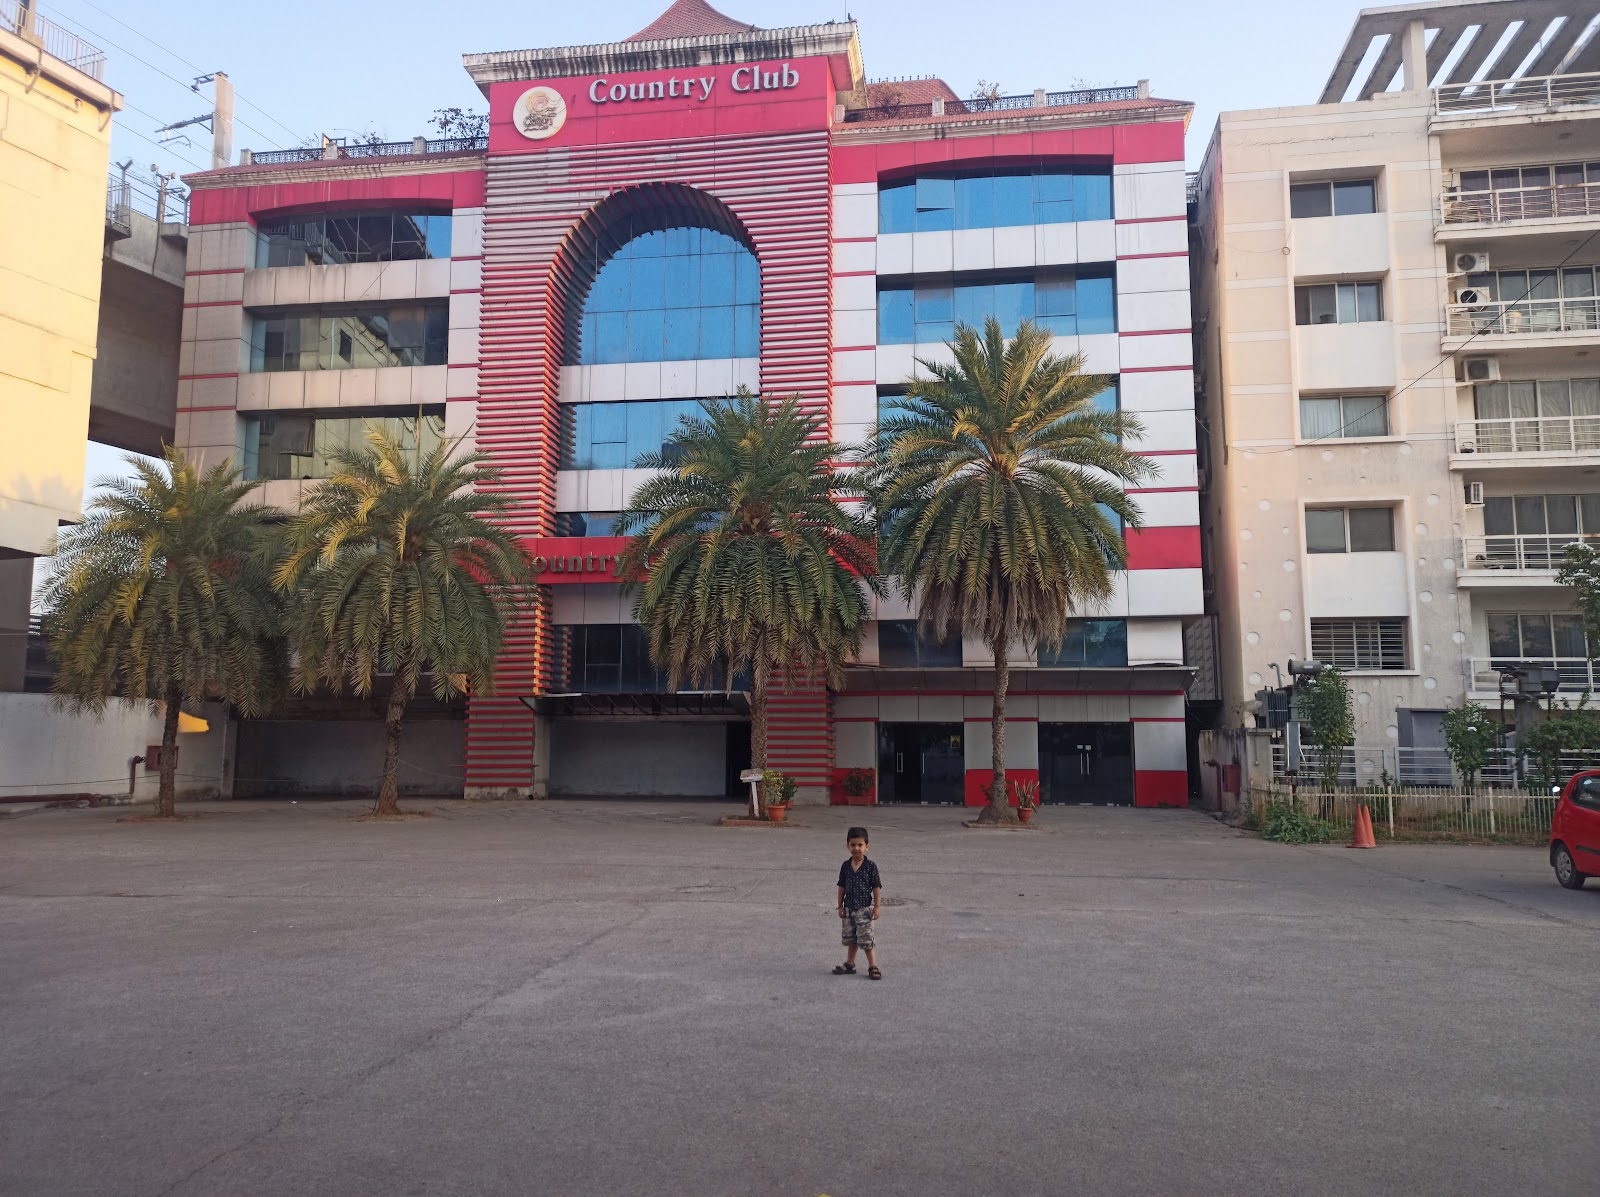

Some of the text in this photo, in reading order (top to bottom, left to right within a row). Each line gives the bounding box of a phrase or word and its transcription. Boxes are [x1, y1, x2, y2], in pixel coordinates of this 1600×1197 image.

[589, 63, 800, 103] Country Club
[527, 551, 626, 577] ountry
